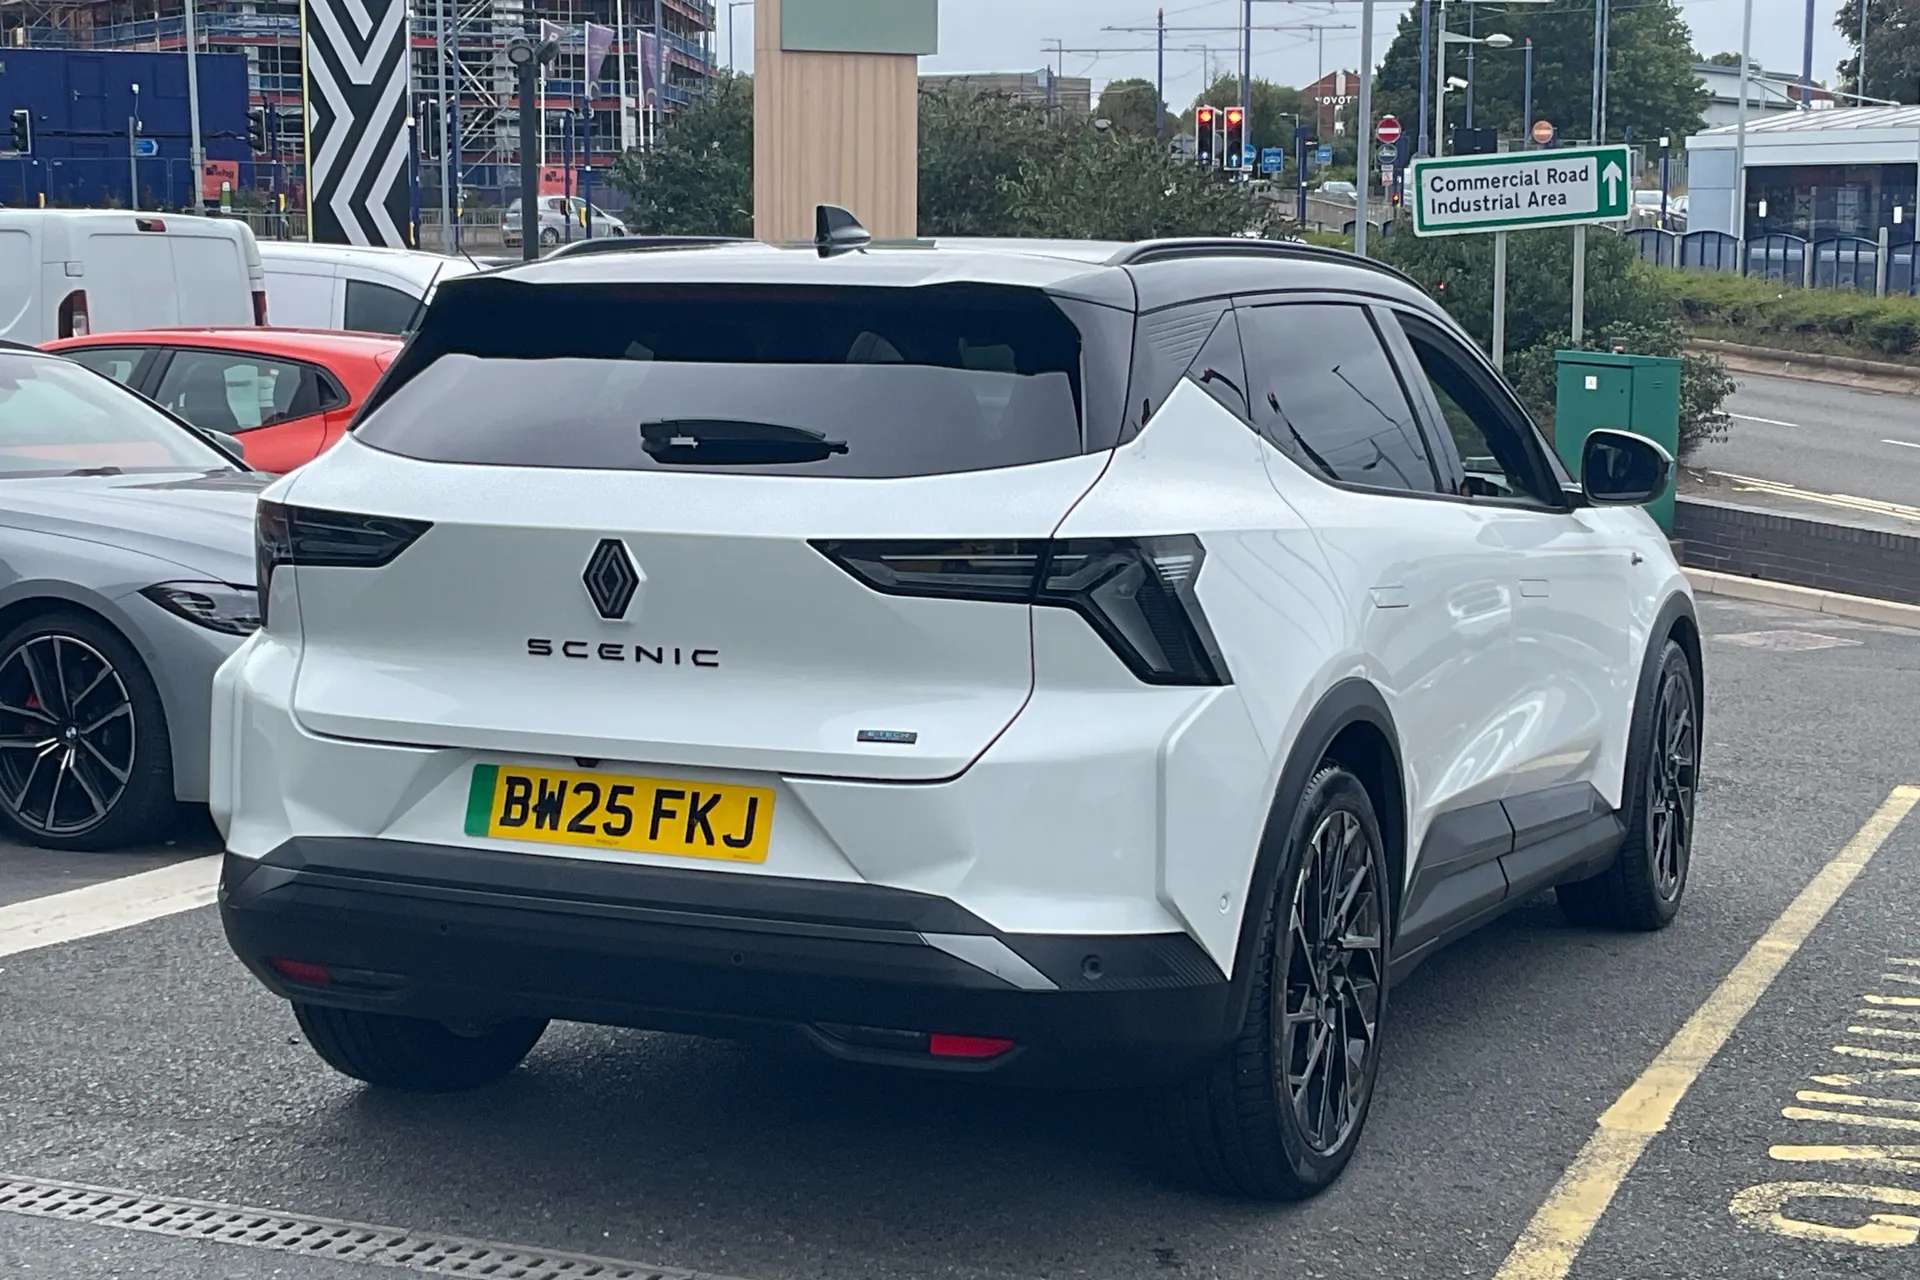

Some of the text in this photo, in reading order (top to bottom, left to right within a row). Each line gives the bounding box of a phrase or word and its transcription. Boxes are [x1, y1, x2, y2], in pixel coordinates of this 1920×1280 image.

[1430, 165, 1589, 193] Commercial Road
[1431, 191, 1567, 215] Industrial Area
[527, 638, 719, 667] SCENIC
[499, 775, 758, 848] BW25 FKJ
